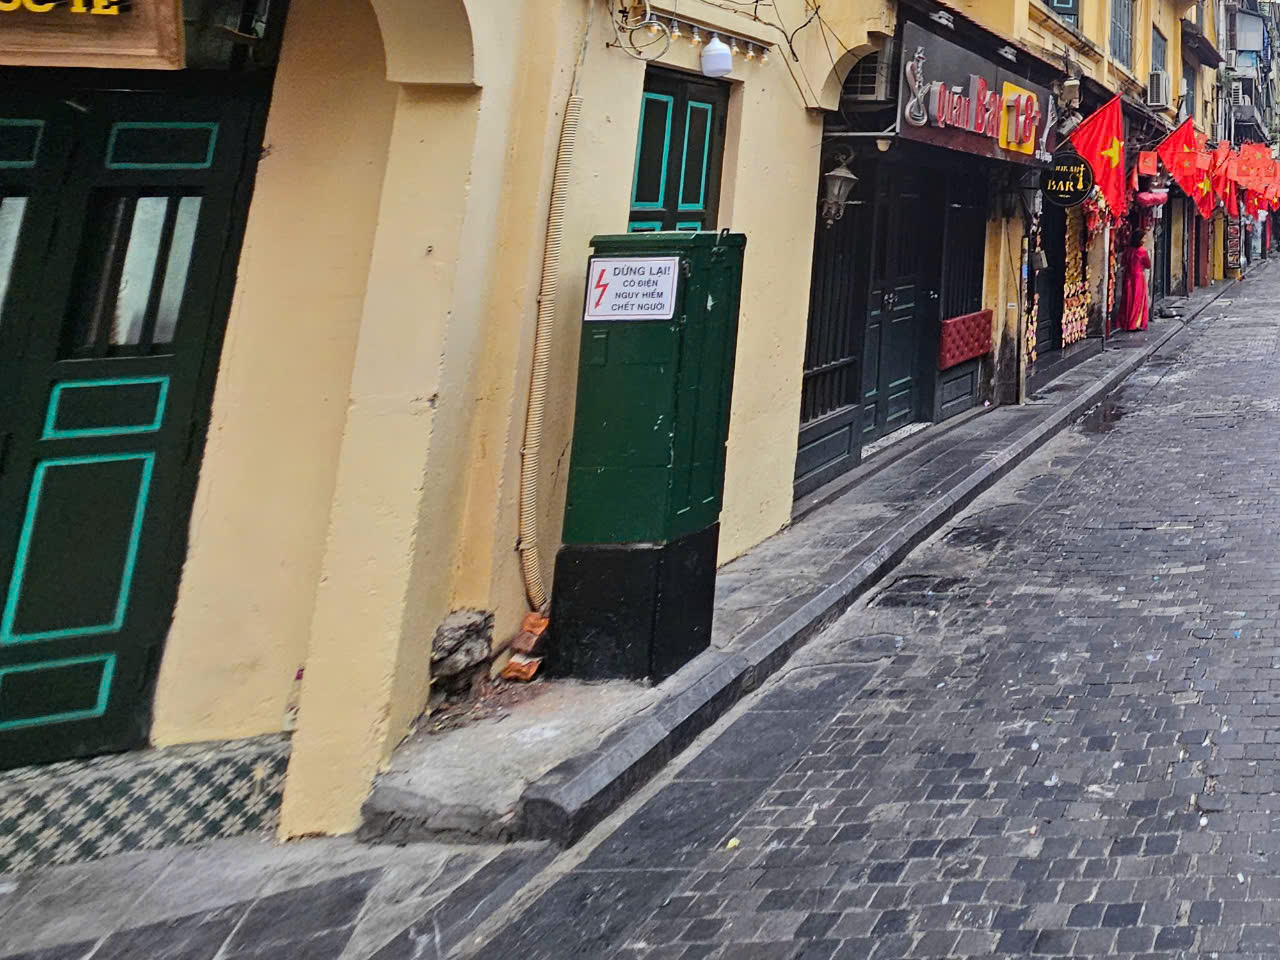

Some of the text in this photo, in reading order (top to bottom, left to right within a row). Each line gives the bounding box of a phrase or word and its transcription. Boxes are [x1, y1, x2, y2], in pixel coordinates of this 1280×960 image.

[1047, 179, 1074, 192] BAR
[649, 266, 671, 278] LẠI!
[615, 291, 640, 300] NGUY
